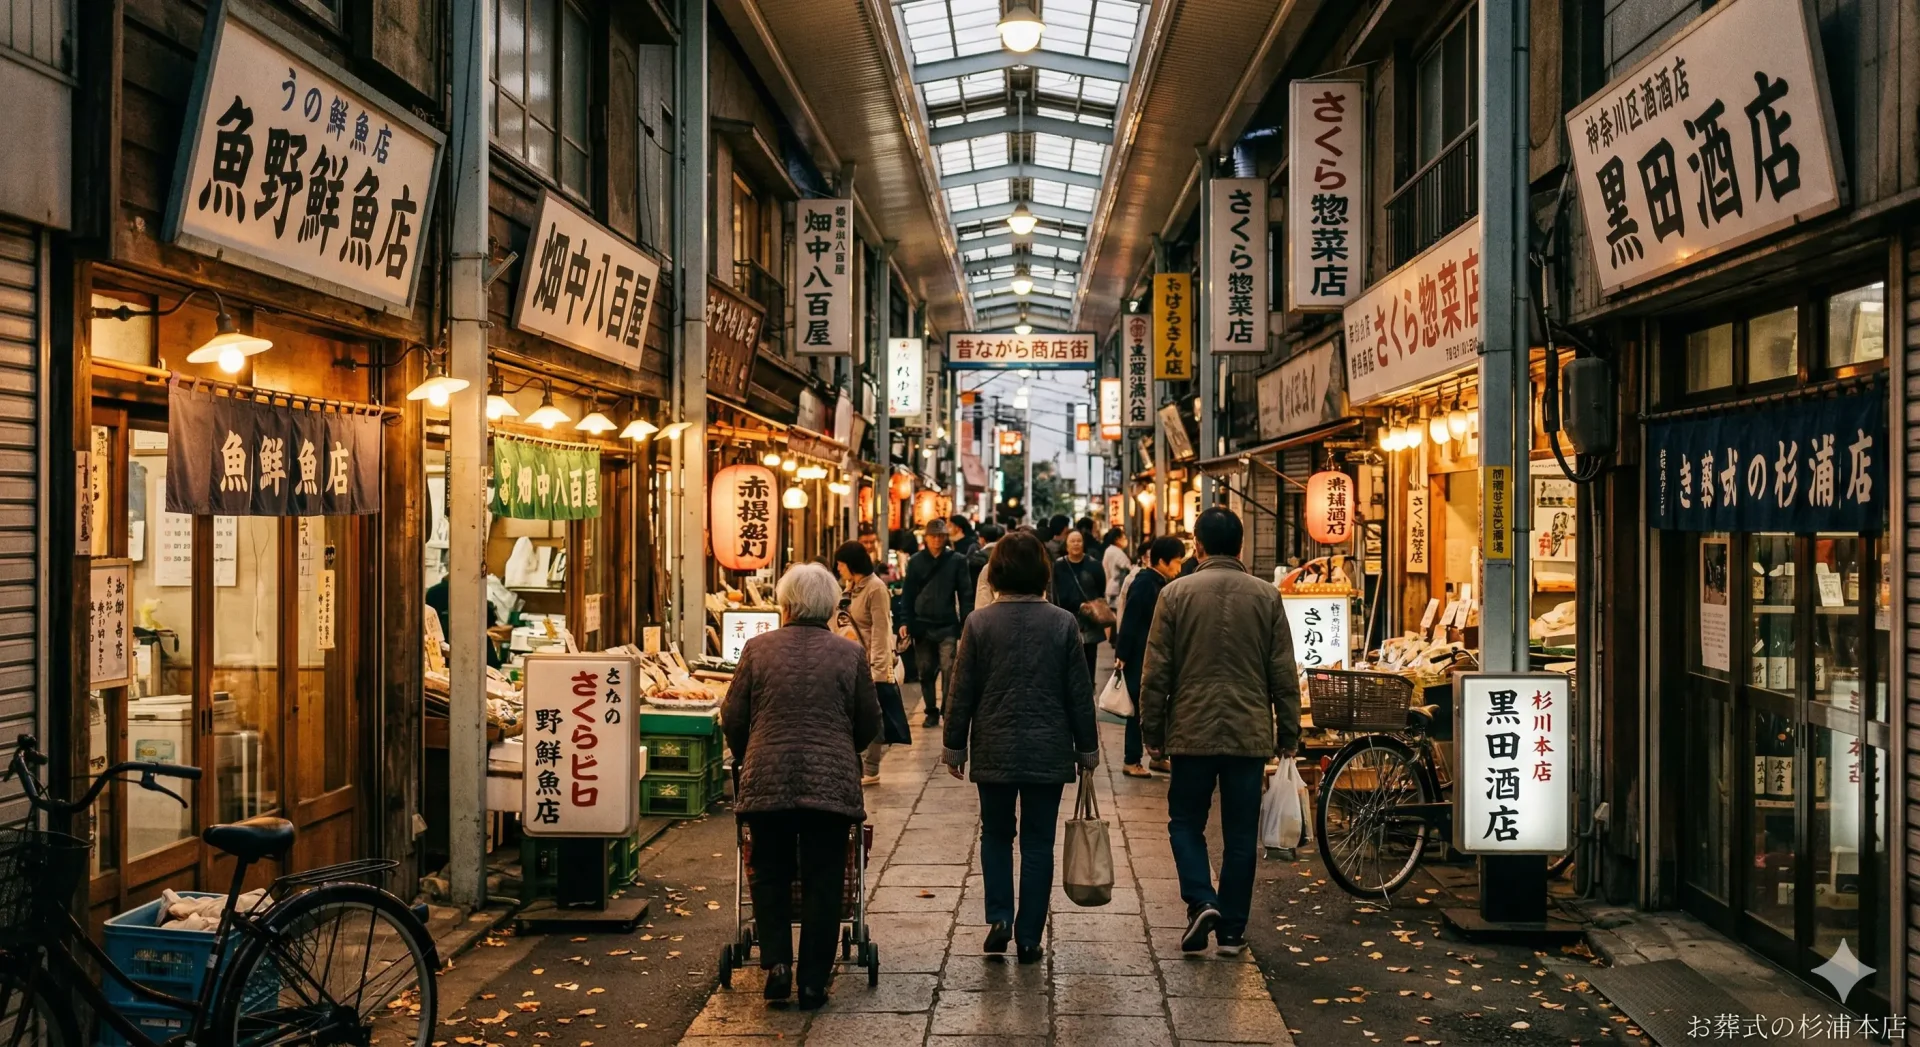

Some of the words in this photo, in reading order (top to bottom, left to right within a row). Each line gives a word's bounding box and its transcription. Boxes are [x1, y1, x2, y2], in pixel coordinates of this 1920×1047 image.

[281, 67, 393, 165] うの鮮魚店
[1585, 56, 1690, 155] 神奈川区酒酒店
[198, 95, 418, 281] 魚野鮮魚店
[1311, 91, 1349, 297] さくら惣菜店
[1595, 71, 1801, 270] 黒田酒店
[532, 222, 651, 349] 畑中八百屋
[804, 209, 833, 346] 畑中八百屋
[1226, 189, 1254, 344] さくら惣菜店
[1374, 247, 1478, 367] さくら惣菜店
[956, 340, 1089, 359] 昔ながら商店街
[220, 430, 350, 498] 魚鮮魚店
[517, 462, 598, 509] 畑中八百屋
[533, 708, 564, 824] 野鮮魚店
[1483, 689, 1521, 841] 黒田酒店
[1531, 689, 1554, 782] 杉川本店
